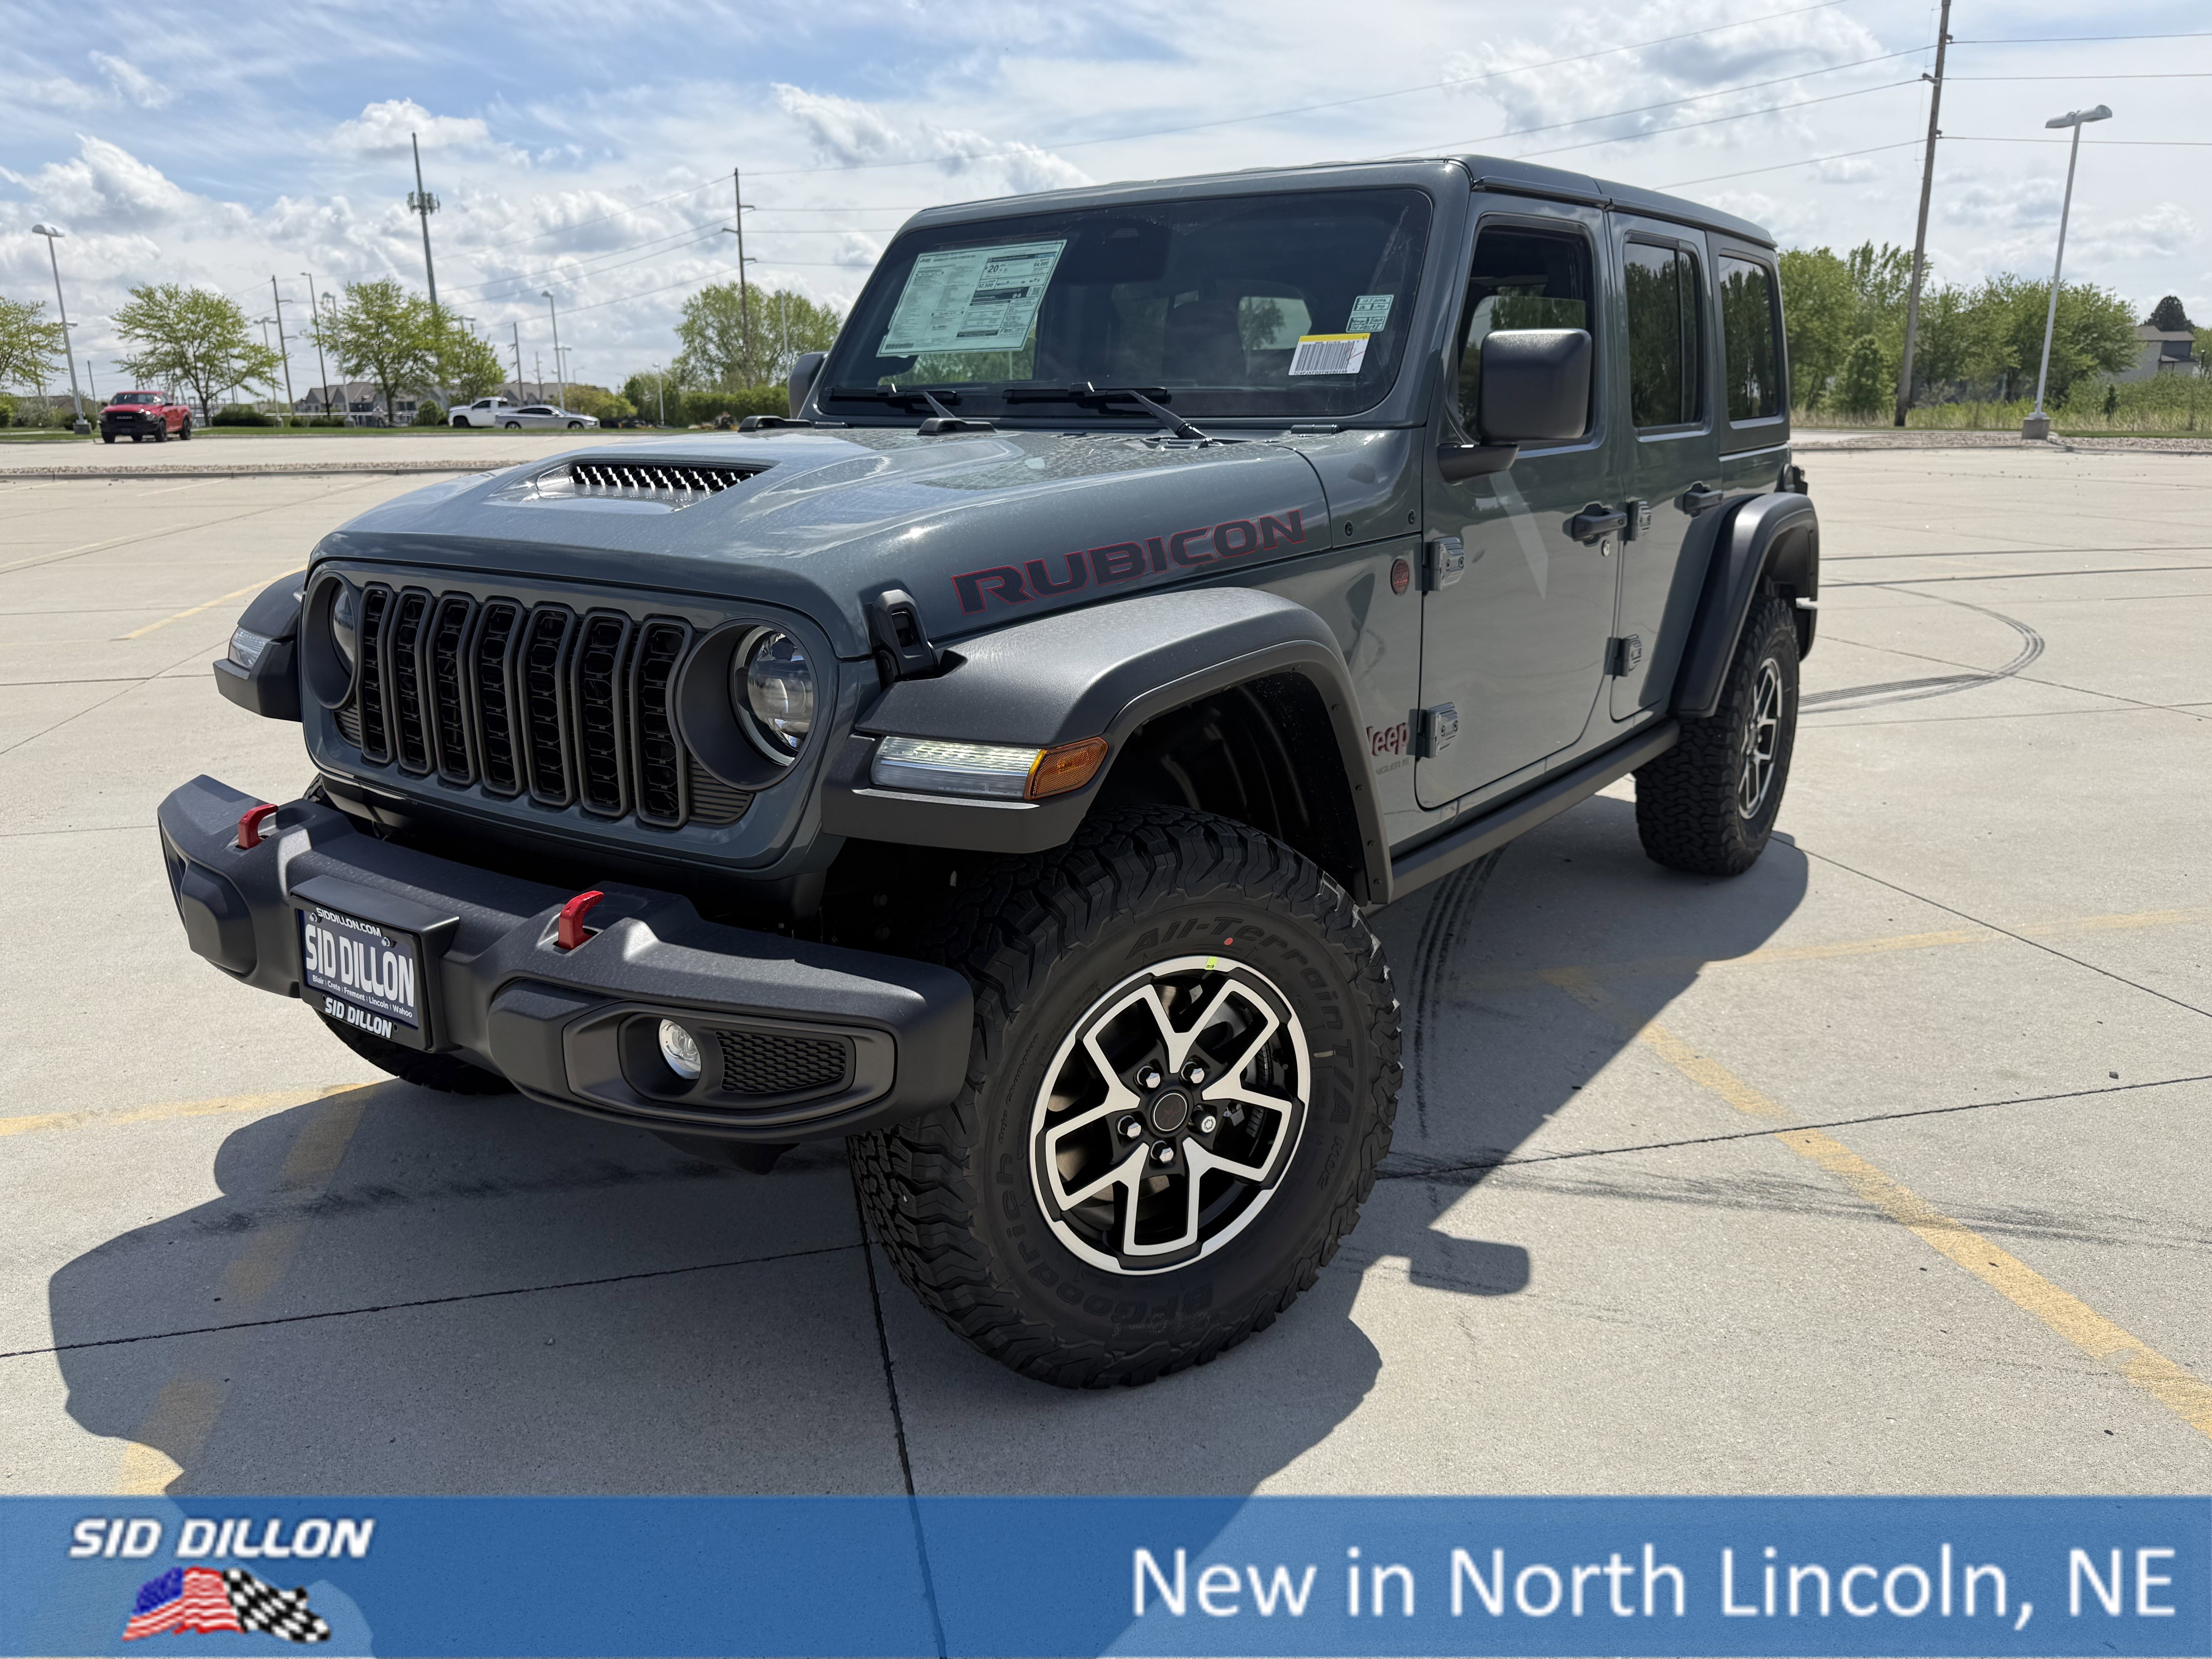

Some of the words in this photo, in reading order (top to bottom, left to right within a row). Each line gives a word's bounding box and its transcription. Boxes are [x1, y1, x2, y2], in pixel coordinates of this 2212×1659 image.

[988, 264, 1000, 273] 20
[950, 509, 1306, 615] RUBICON
[316, 907, 382, 937] SIDDILLON.COM
[305, 924, 336, 979] SID
[339, 936, 414, 1007] DILLON
[312, 974, 325, 985] Blair
[327, 980, 341, 992] Crete
[344, 987, 366, 1002] Fremont
[369, 996, 389, 1010] Lincoln
[393, 1004, 413, 1018] Wahoo
[325, 997, 345, 1019] SID
[347, 1005, 393, 1039] DILLON
[1125, 917, 1344, 1030] All-Terrain
[1330, 1039, 1354, 1123] T/A
[997, 1153, 1212, 1324] BFGoodrich
